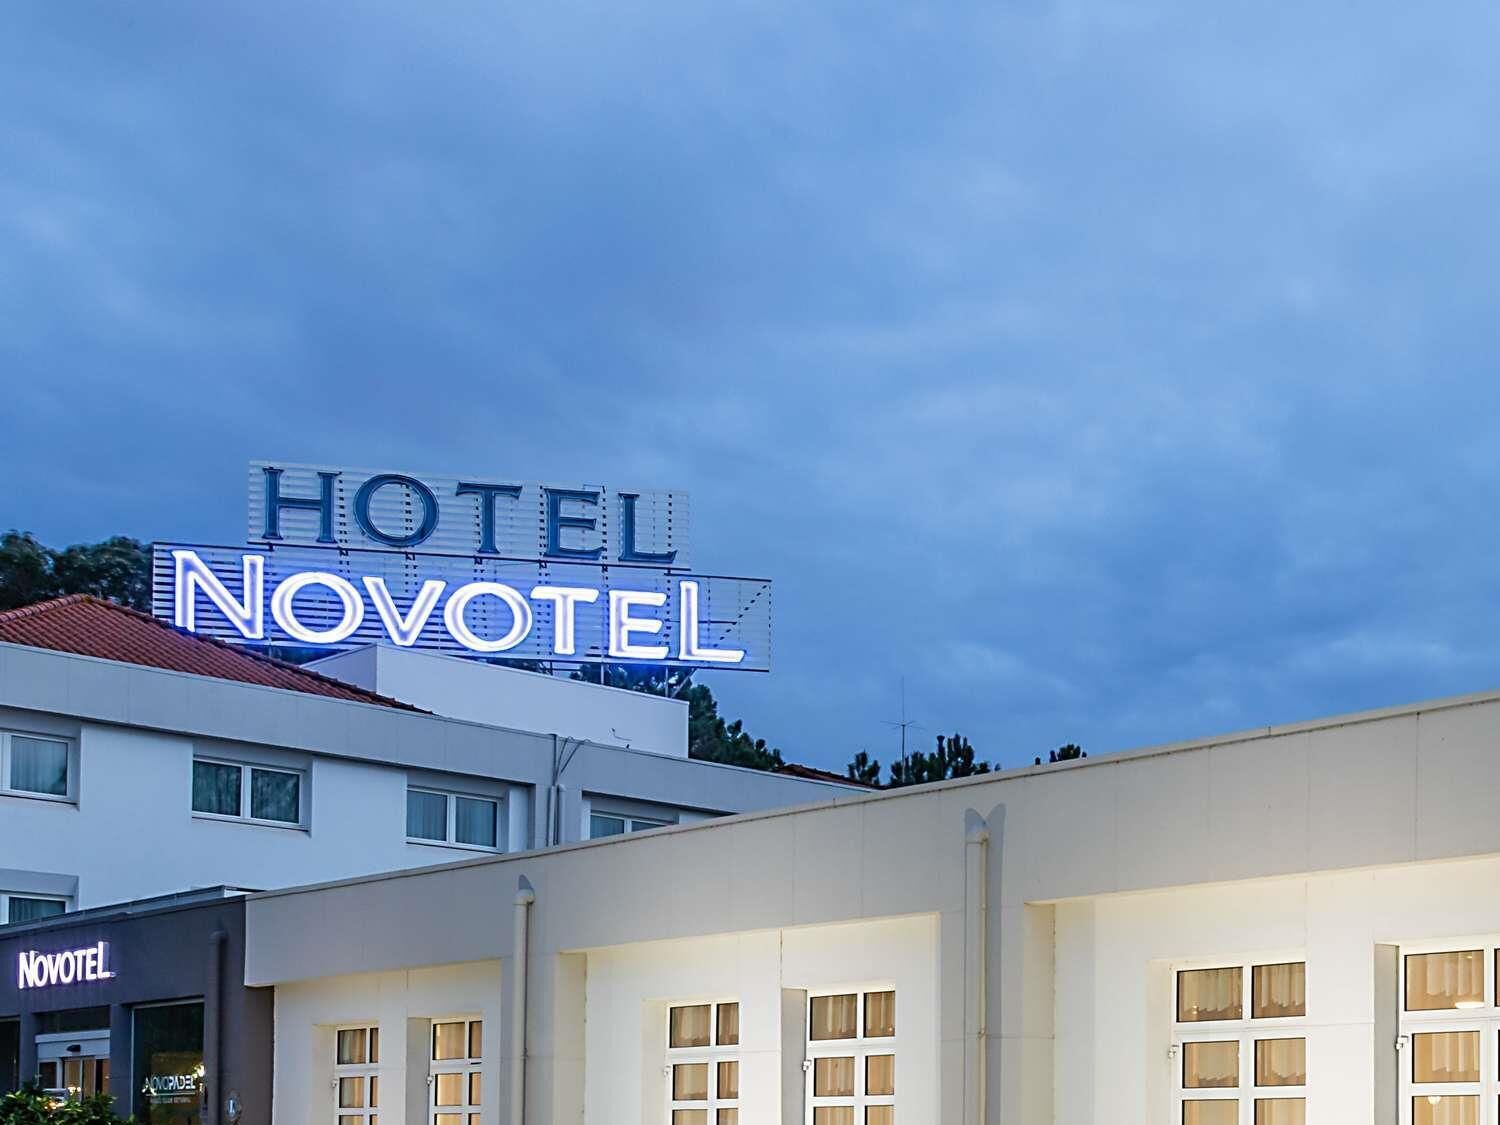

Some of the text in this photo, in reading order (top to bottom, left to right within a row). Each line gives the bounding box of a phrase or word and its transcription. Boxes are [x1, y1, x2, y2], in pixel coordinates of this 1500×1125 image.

[261, 465, 677, 562] HOTEL
[171, 549, 745, 663] NOVOTEL
[18, 941, 115, 989] NOVOTEL
